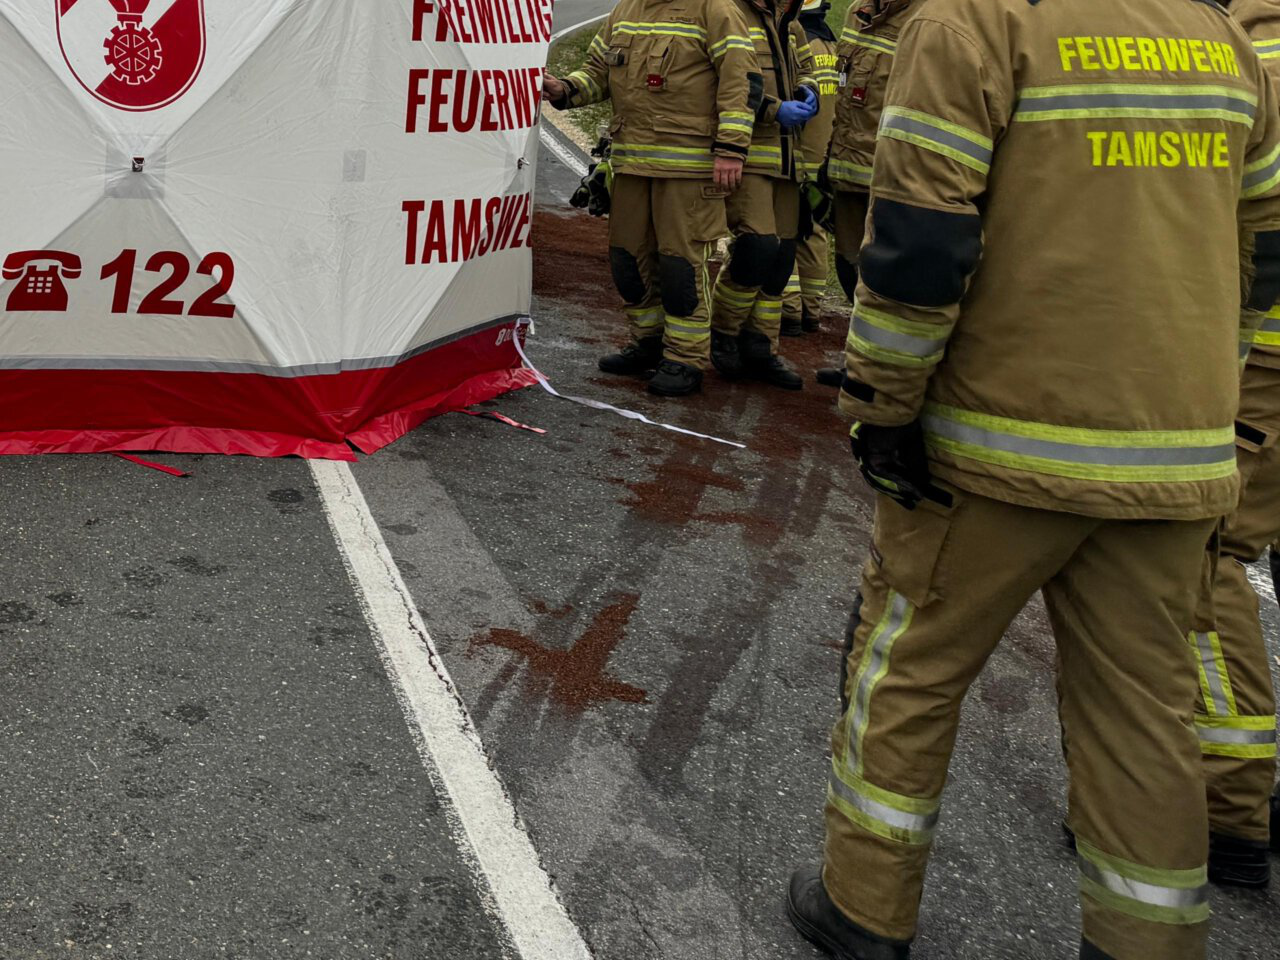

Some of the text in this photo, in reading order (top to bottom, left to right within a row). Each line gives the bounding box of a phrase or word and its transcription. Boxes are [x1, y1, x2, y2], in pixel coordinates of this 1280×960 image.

[1057, 36, 1240, 78] FEUERWEHR
[405, 67, 545, 133] FEUERWE
[100, 248, 236, 319] 122
